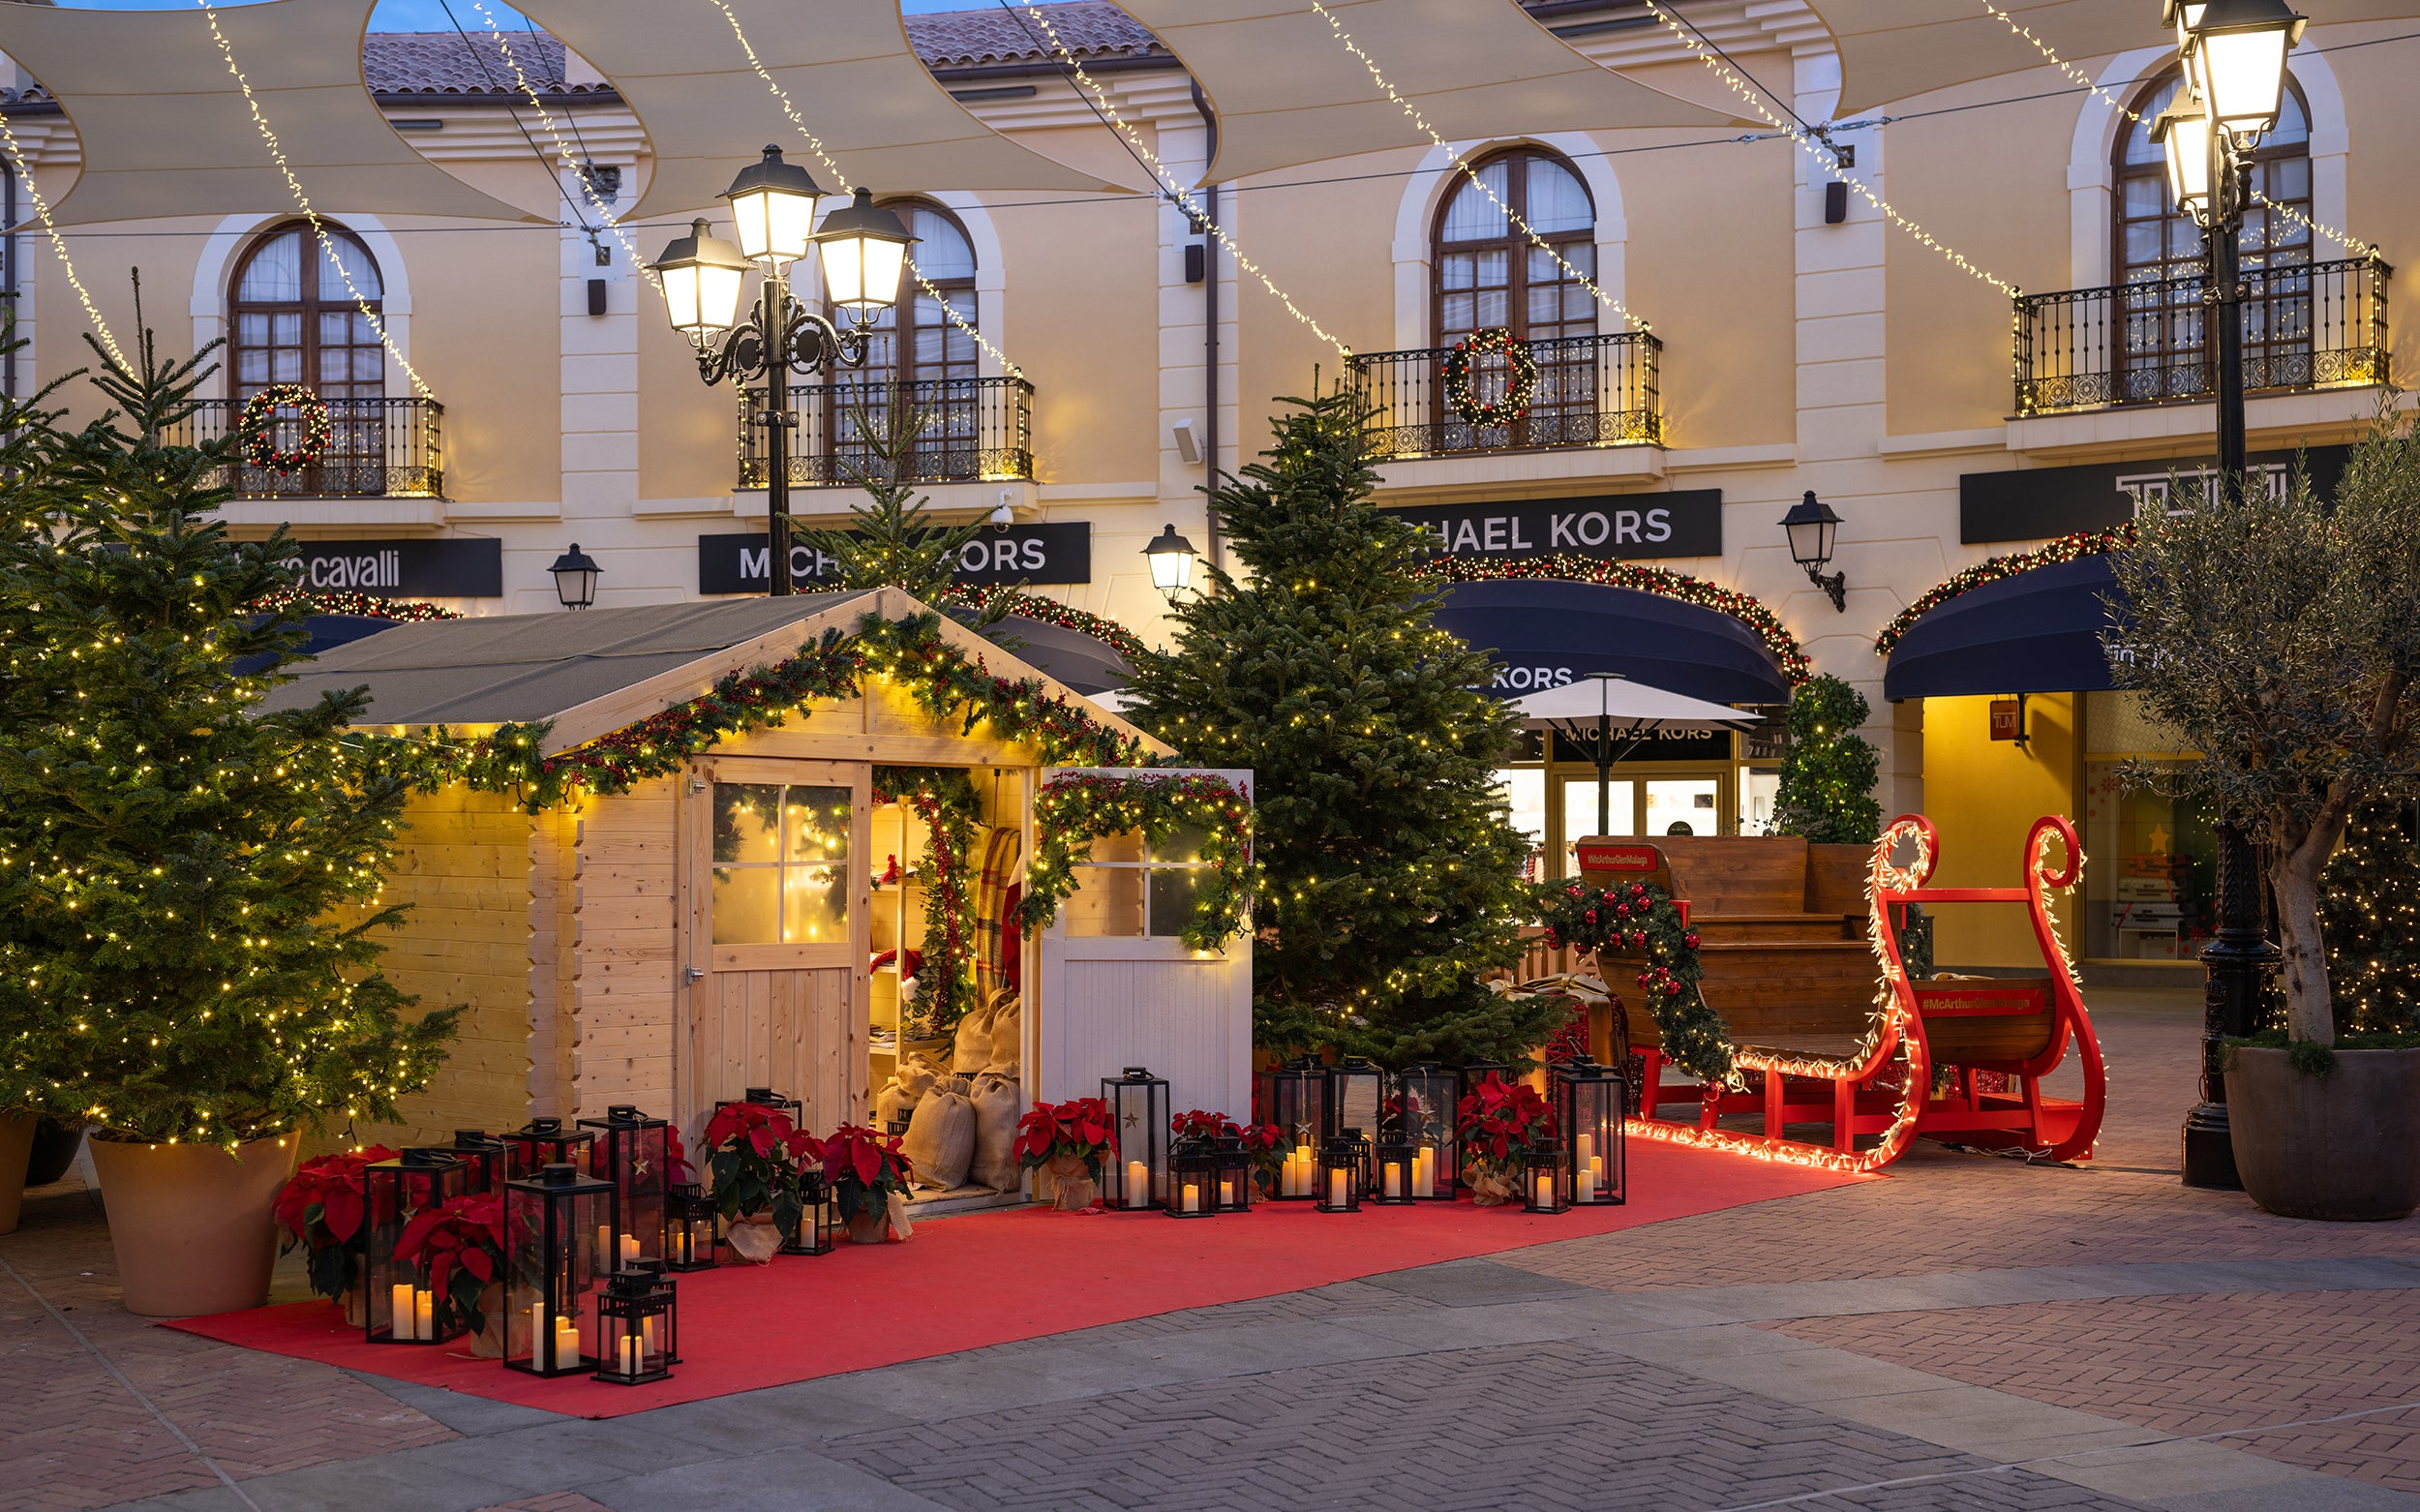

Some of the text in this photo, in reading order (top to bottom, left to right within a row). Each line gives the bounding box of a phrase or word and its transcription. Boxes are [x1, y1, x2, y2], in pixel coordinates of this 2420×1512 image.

[1400, 508, 1672, 554] HAEL KORS
[311, 550, 400, 588] cavalli
[1492, 666, 1573, 689] KORS
